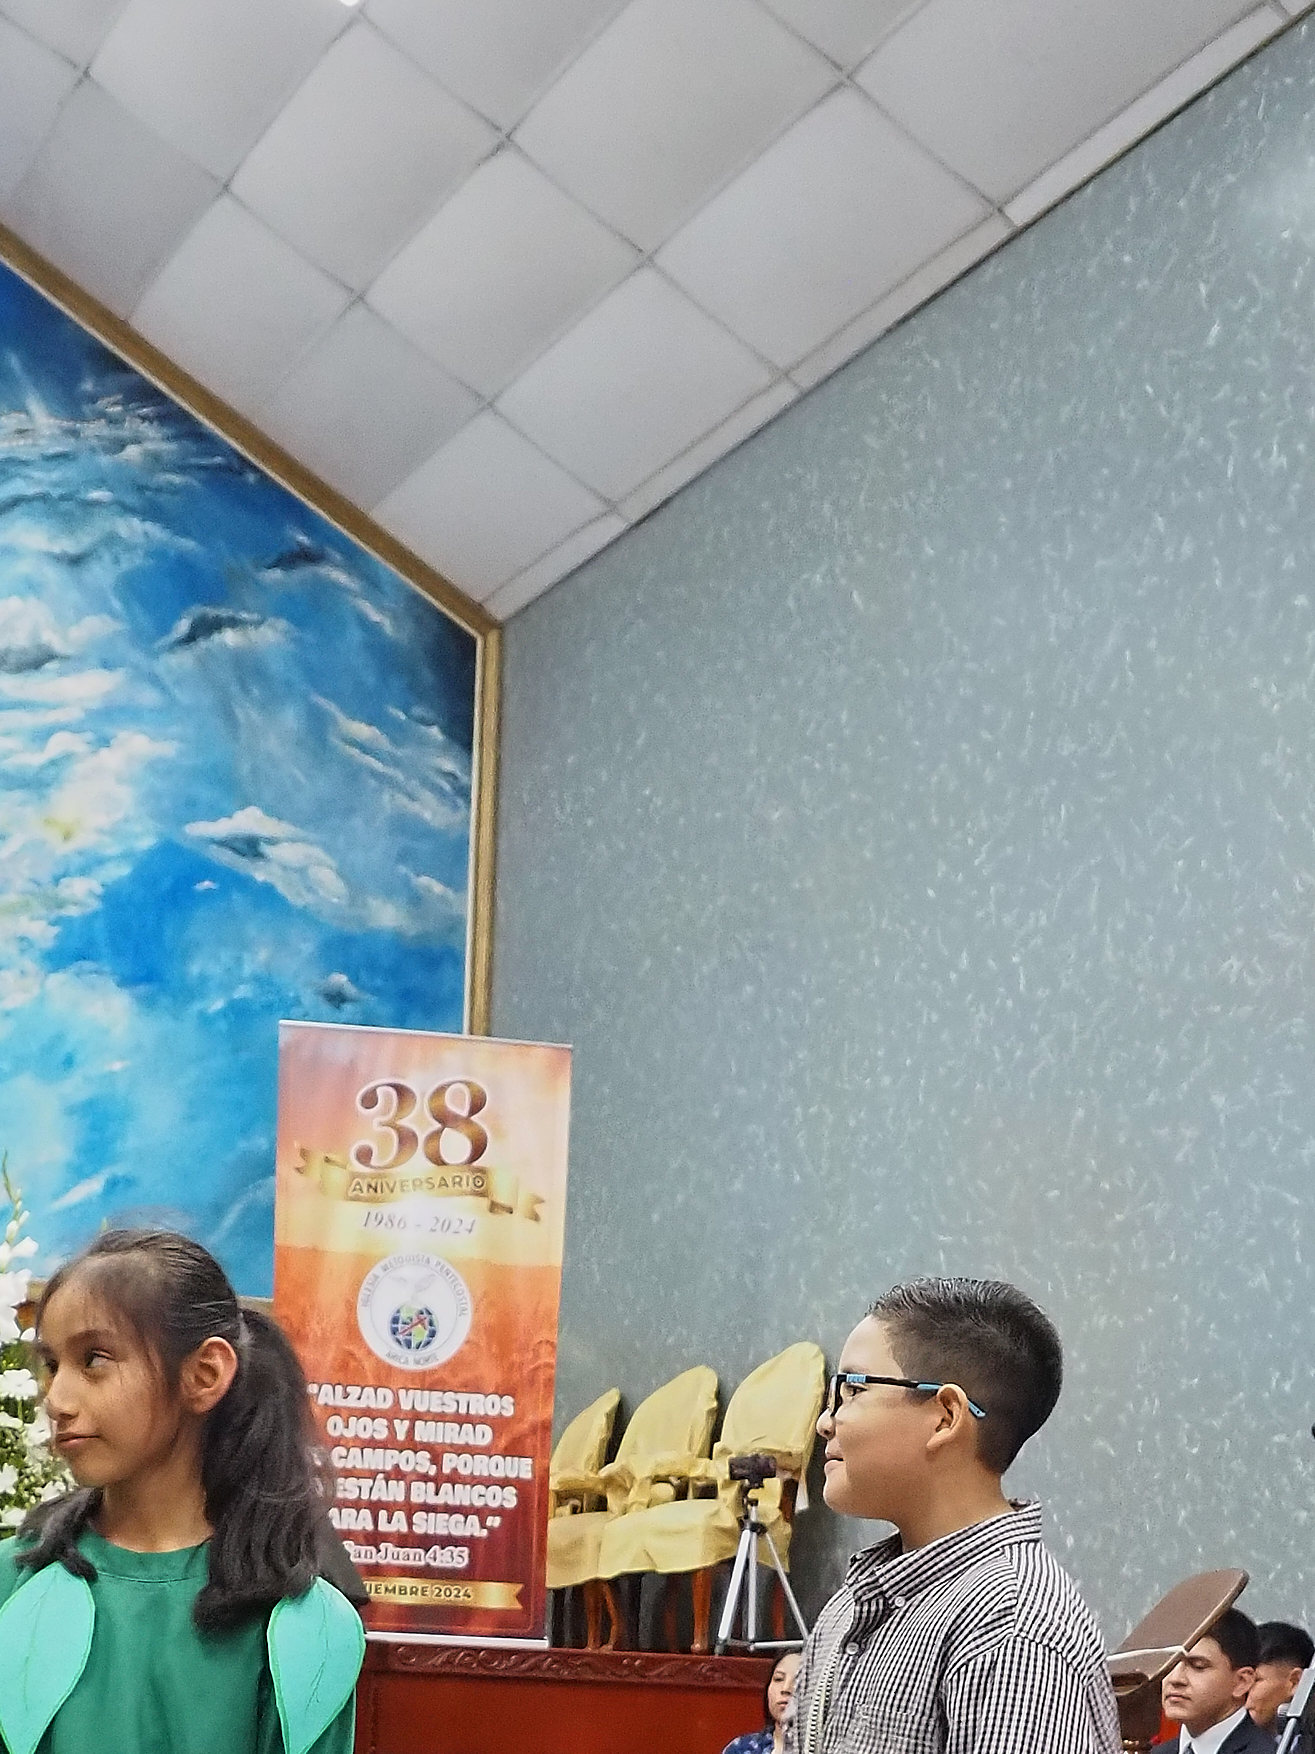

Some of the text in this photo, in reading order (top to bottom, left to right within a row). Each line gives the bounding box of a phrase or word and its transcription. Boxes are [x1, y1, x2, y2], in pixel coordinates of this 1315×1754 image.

[356, 1079, 488, 1169] 38
[351, 1174, 485, 1195] ANIVERSARIO
[363, 1211, 407, 1230] 1986
[429, 1215, 477, 1235] 2024
[398, 1388, 515, 1417] VUESTROS
[326, 1415, 494, 1446] OJOS Y MIRAD
[331, 1446, 437, 1476] CAMPOS,
[442, 1452, 533, 1479] PORQUE
[336, 1473, 405, 1502] ESTÁN
[410, 1481, 518, 1509] BLANCOS
[329, 1507, 374, 1531] ARA
[378, 1509, 408, 1532] LA
[346, 1543, 468, 1566] an Juan 4:35
[366, 1583, 472, 1599] IEMBRE 2024
